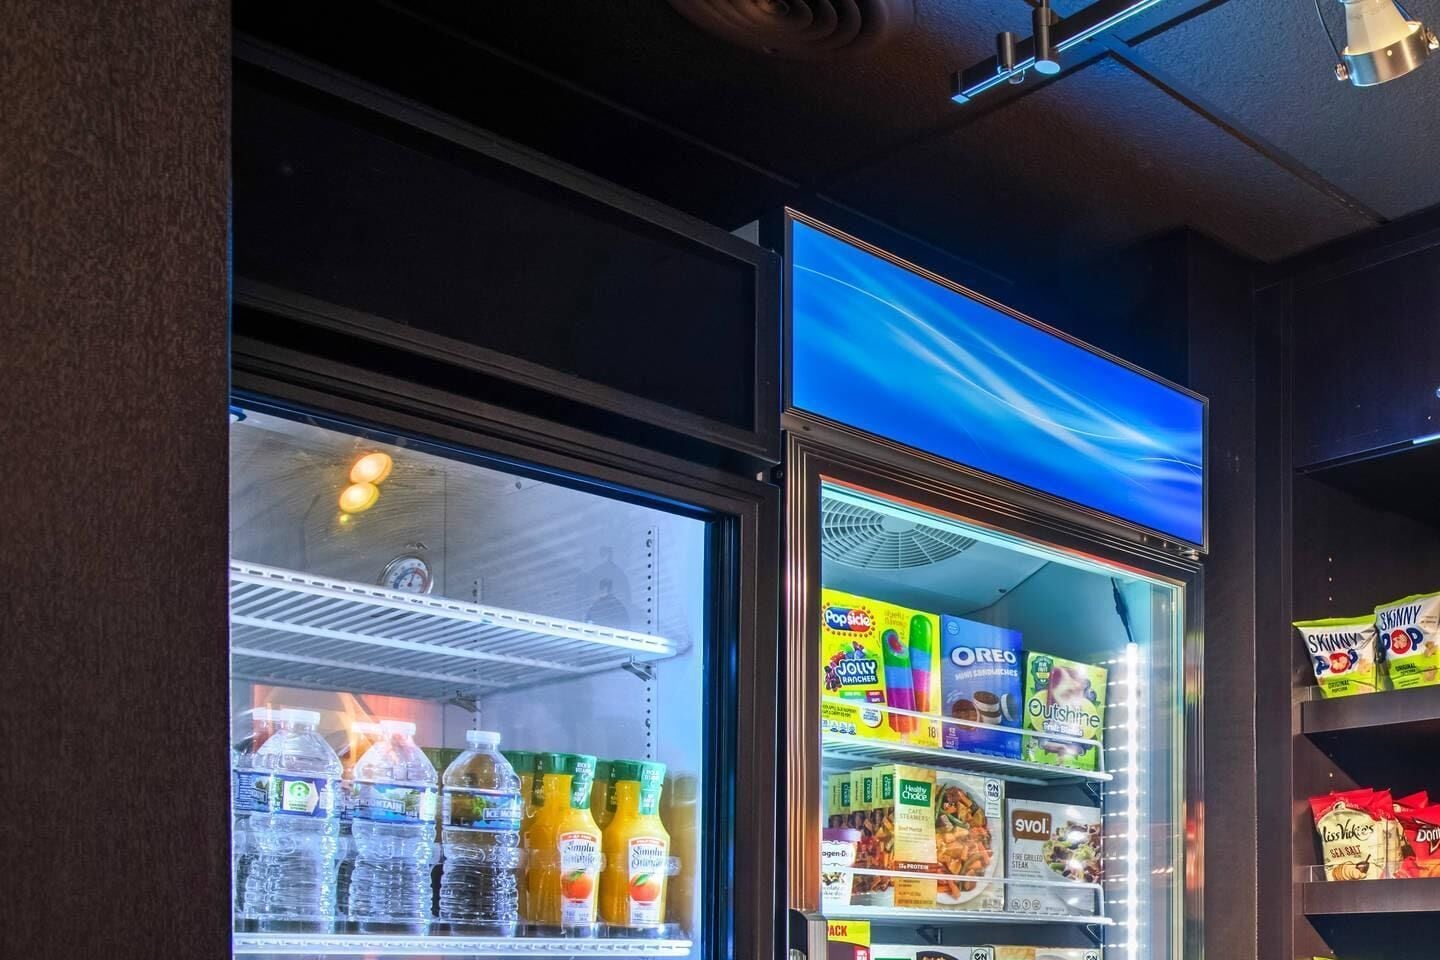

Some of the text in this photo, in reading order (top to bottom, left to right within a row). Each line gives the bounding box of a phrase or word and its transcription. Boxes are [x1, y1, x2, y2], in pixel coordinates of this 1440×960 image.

[825, 609, 870, 628] Popsicle
[951, 646, 1016, 666] OREO
[1313, 648, 1358, 675] POP
[839, 660, 876, 675] JOLLY
[842, 675, 877, 683] RANCHER
[1029, 698, 1101, 728] Outshine
[928, 727, 936, 738] 18
[902, 791, 928, 801] Choice
[905, 784, 927, 795] Healthy
[1330, 845, 1361, 858] SEA SALT
[1012, 860, 1029, 869] STEAK
